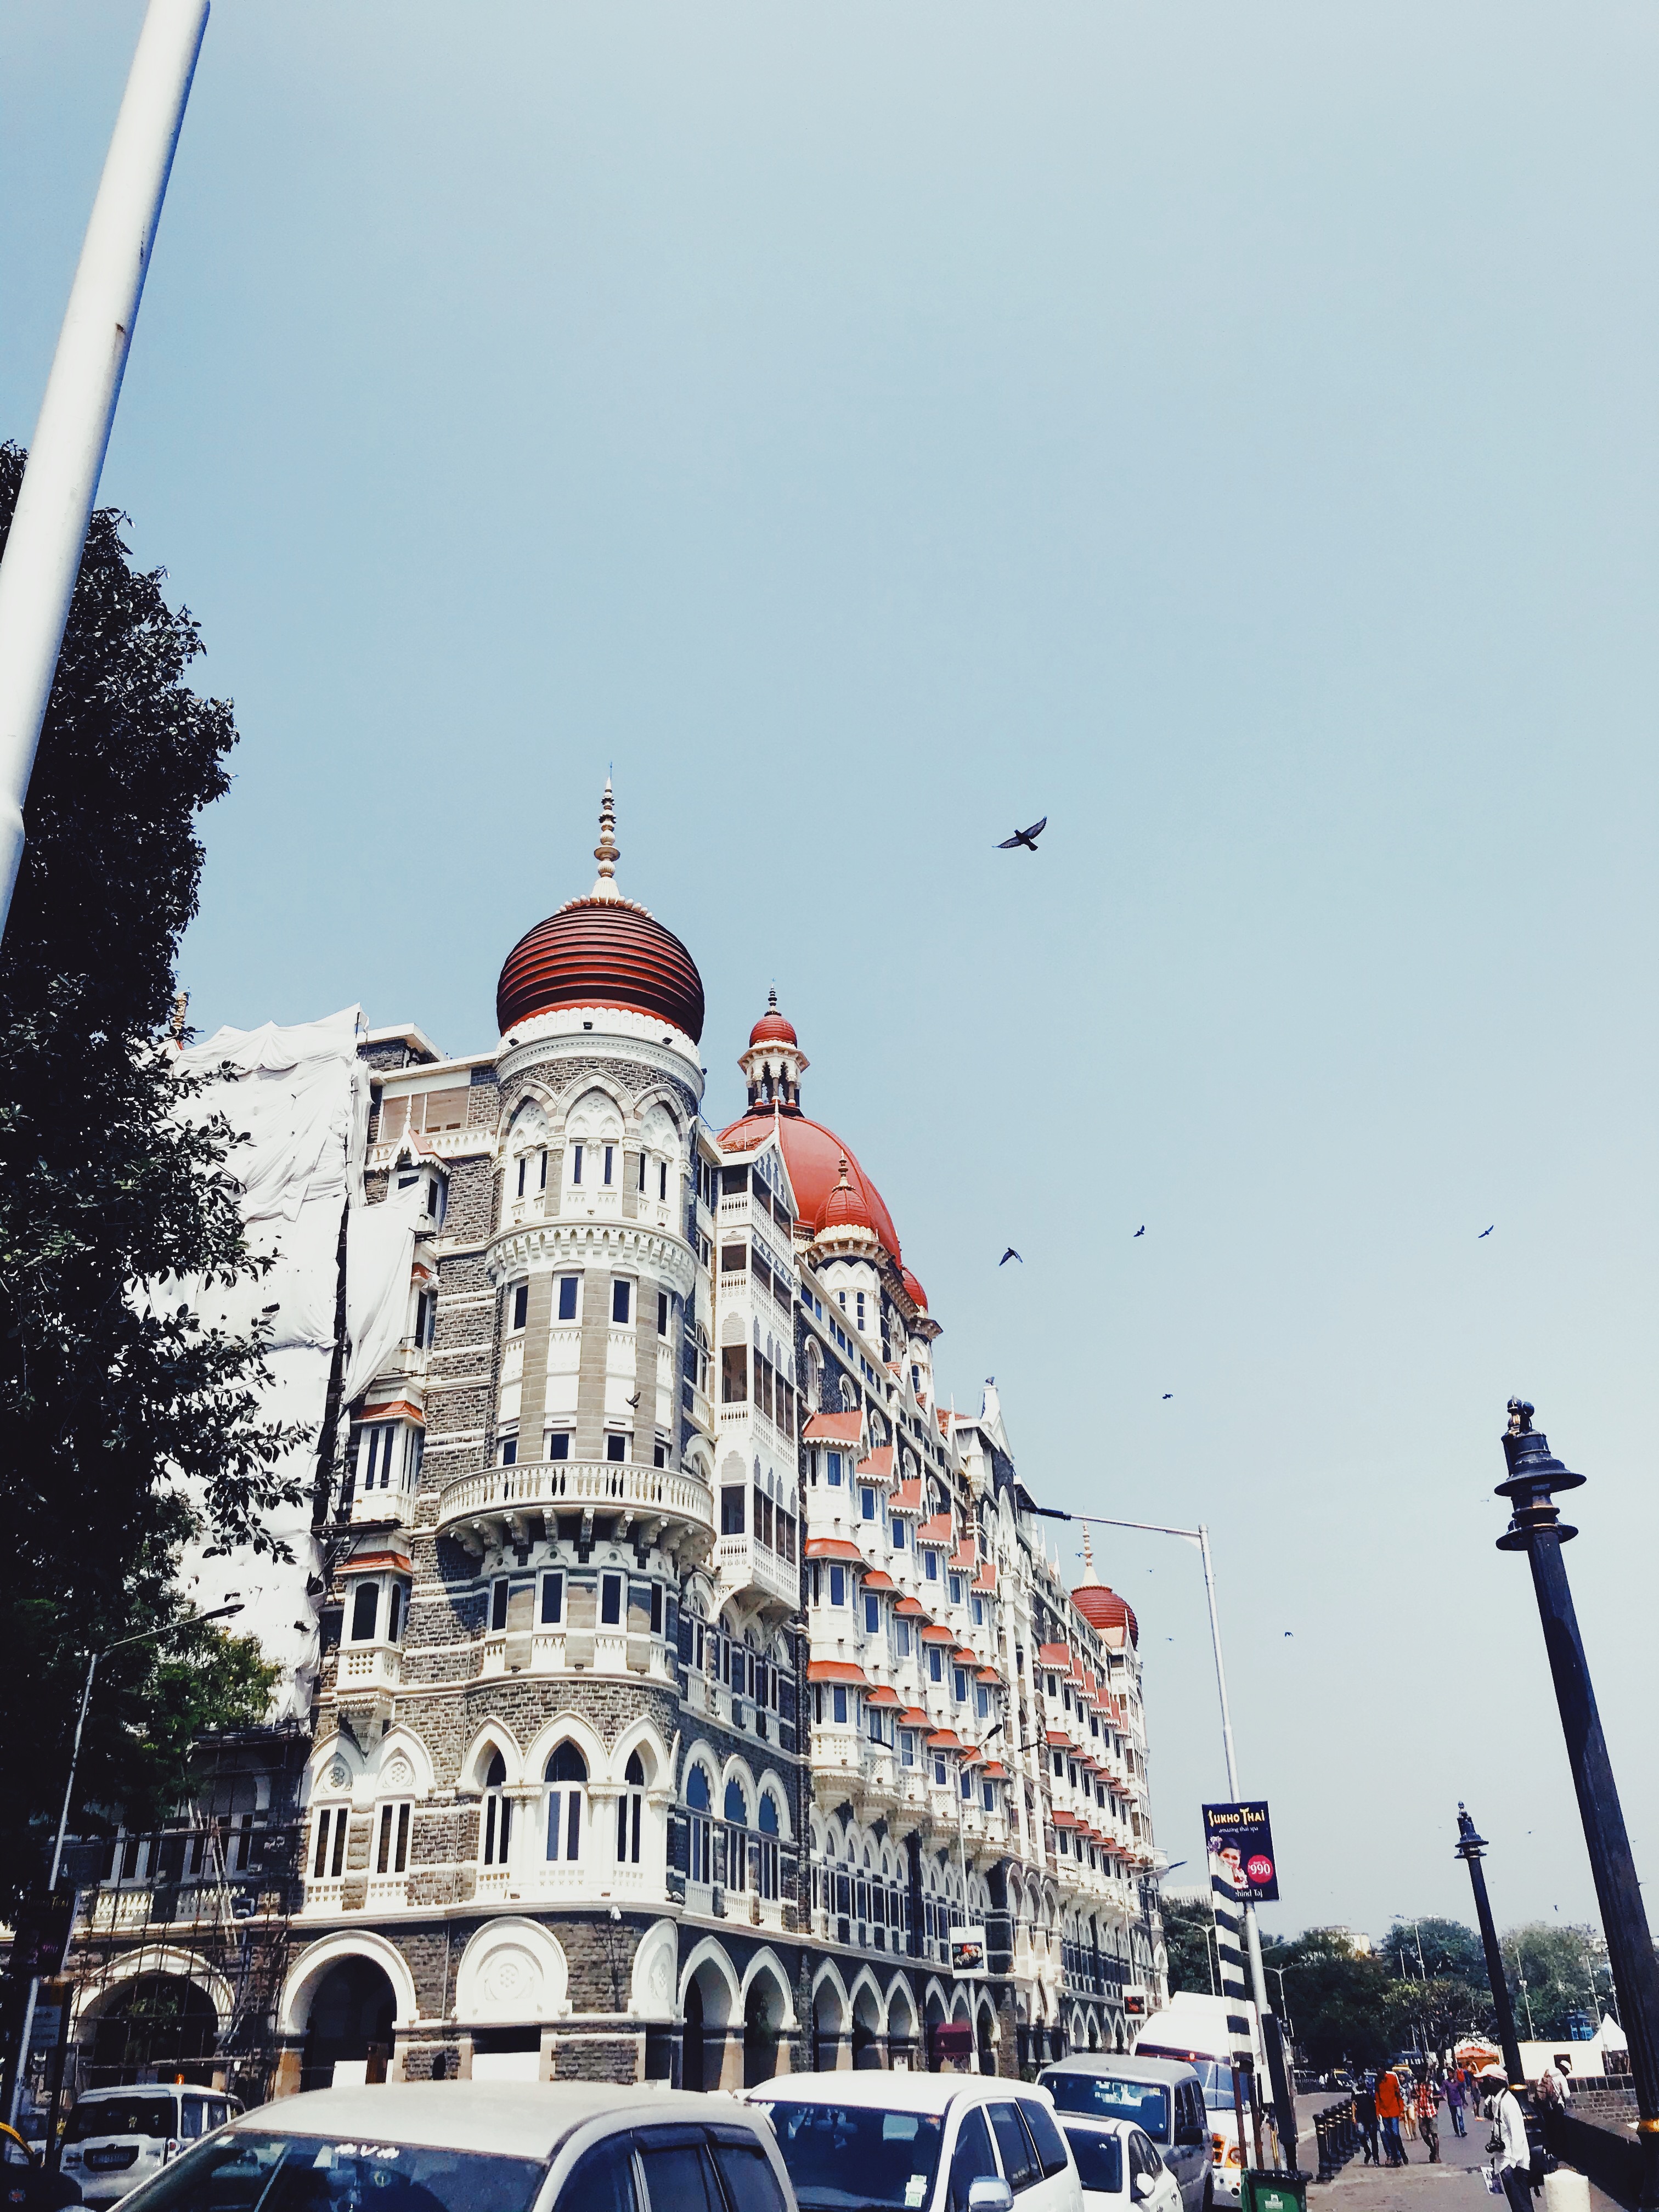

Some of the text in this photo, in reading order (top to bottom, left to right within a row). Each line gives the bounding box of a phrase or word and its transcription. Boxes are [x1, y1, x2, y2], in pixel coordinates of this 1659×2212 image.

[1207, 1807, 1265, 1827] SUKHO THAI
[1254, 1889, 1263, 1898] Taj
